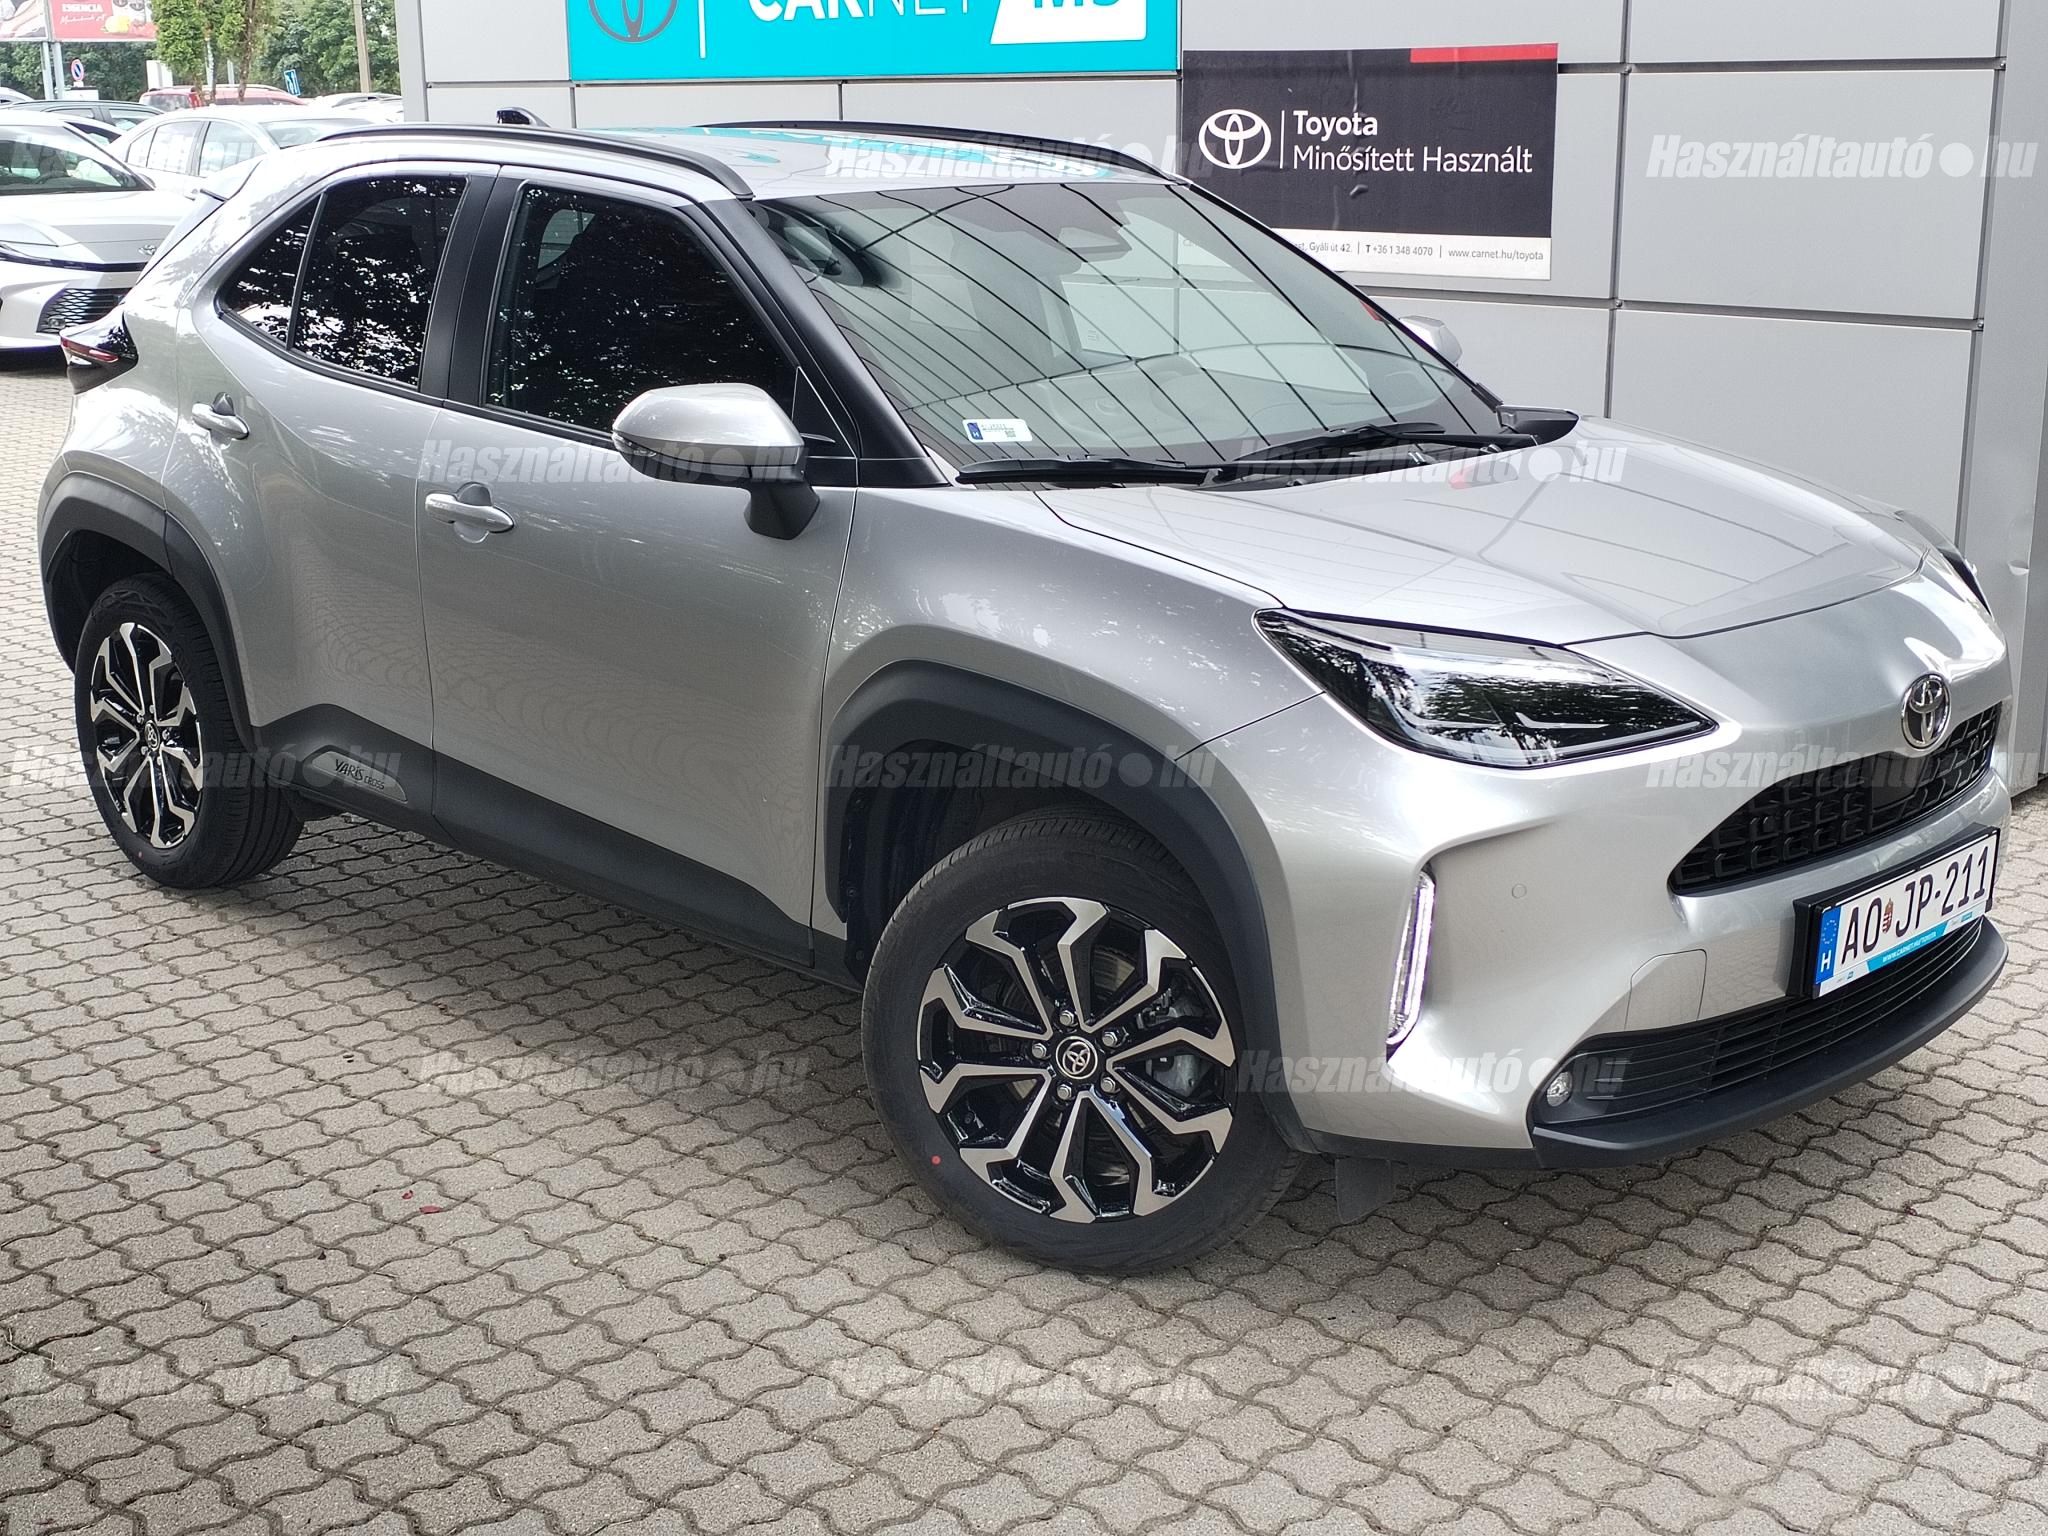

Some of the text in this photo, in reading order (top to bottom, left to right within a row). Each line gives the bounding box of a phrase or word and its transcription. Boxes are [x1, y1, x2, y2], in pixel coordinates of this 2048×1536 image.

[1293, 109, 1379, 142] Toyota
[1293, 143, 1534, 174] Minősített Használt
[1373, 245, 1388, 255] +36
[1394, 246, 1410, 255] 348
[1412, 246, 1433, 257] 4070
[1448, 247, 1544, 261] www.carnet.hu/toyota
[1841, 896, 1882, 965] AO
[1820, 949, 1832, 973] H
